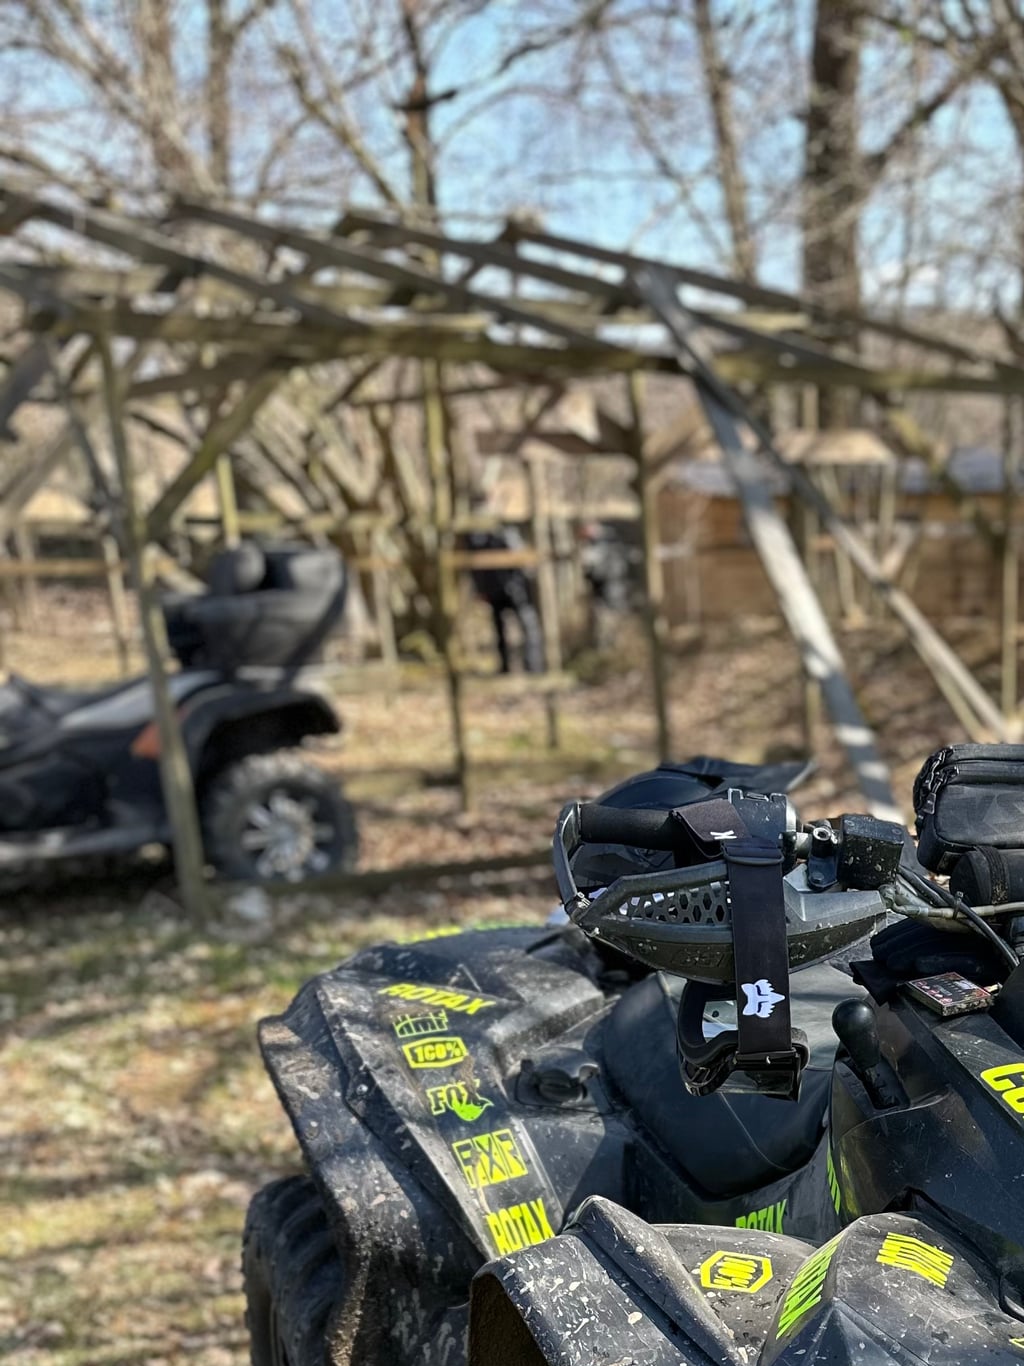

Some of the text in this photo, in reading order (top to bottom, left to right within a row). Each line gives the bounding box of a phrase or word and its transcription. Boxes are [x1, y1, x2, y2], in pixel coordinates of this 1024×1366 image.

[378, 983, 497, 1015] ROTAX
[414, 1042, 461, 1063] 100%
[426, 1079, 490, 1119] FOX
[453, 1128, 529, 1189] FXR
[486, 1198, 556, 1256] ROTAX
